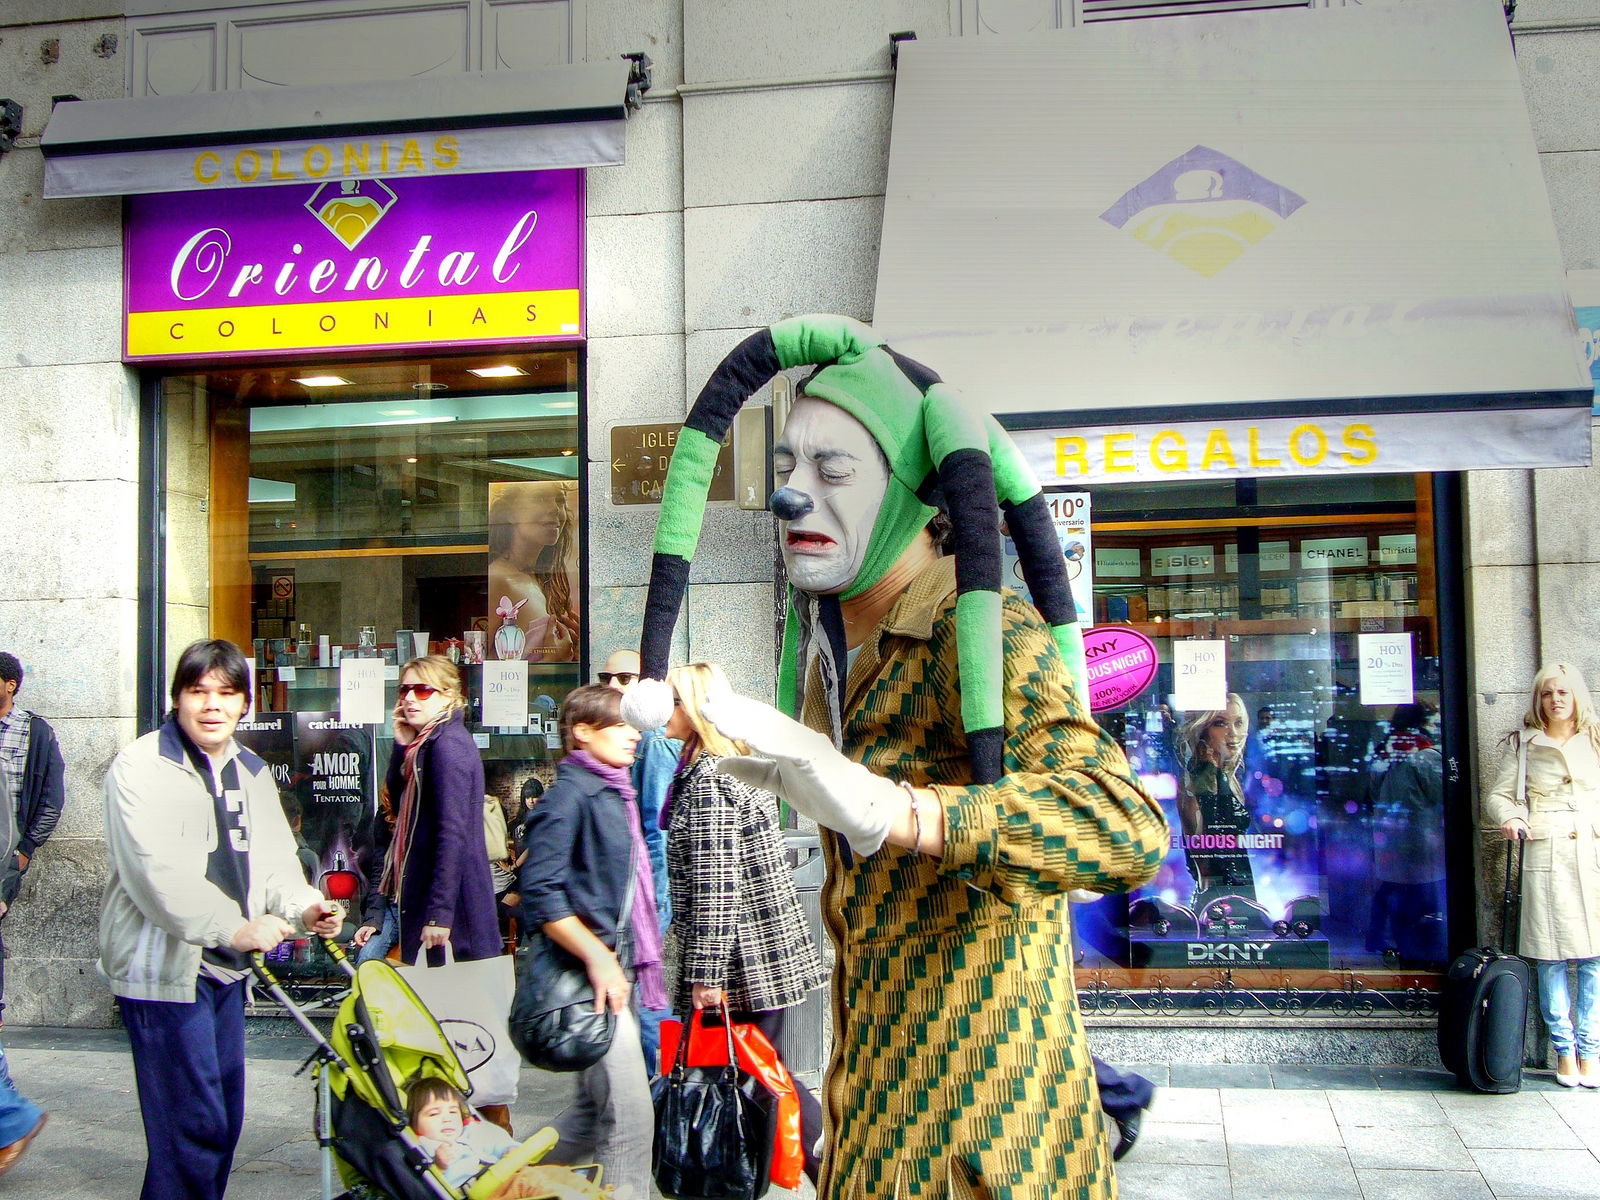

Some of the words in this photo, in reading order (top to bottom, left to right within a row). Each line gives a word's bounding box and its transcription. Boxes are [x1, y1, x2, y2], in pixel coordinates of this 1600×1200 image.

[193, 135, 460, 184] COLONIAS
[169, 210, 539, 302] Oriental
[170, 304, 537, 340] COLONIAS
[642, 431, 680, 448] IGLE
[1055, 423, 1379, 477] REGALOS
[641, 480, 665, 496] CA
[1307, 547, 1363, 559] CHANEL
[1382, 547, 1416, 555] Christia
[1154, 554, 1210, 569] sisley
[1085, 638, 1118, 658] KNY
[1380, 645, 1404, 655] HOY
[1087, 662, 1112, 681] OUS
[1112, 648, 1148, 671] NIGHT
[1194, 652, 1216, 662] HOY
[1367, 658, 1383, 669] 20
[500, 671, 521, 681] HOY
[1181, 664, 1196, 675] 20
[488, 682, 503, 693] 20
[1094, 685, 1122, 700] 100%
[1102, 695, 1120, 706] NEW
[1118, 684, 1138, 699] YORK
[236, 717, 282, 731] acharel
[312, 752, 360, 775] AMOR
[271, 762, 291, 784] MOR
[313, 780, 327, 790] POUR
[329, 775, 360, 790] HOMME
[1171, 834, 1236, 849] ELICIOUS
[1238, 834, 1285, 849] NIGHT
[1187, 943, 1271, 960] DKNY
